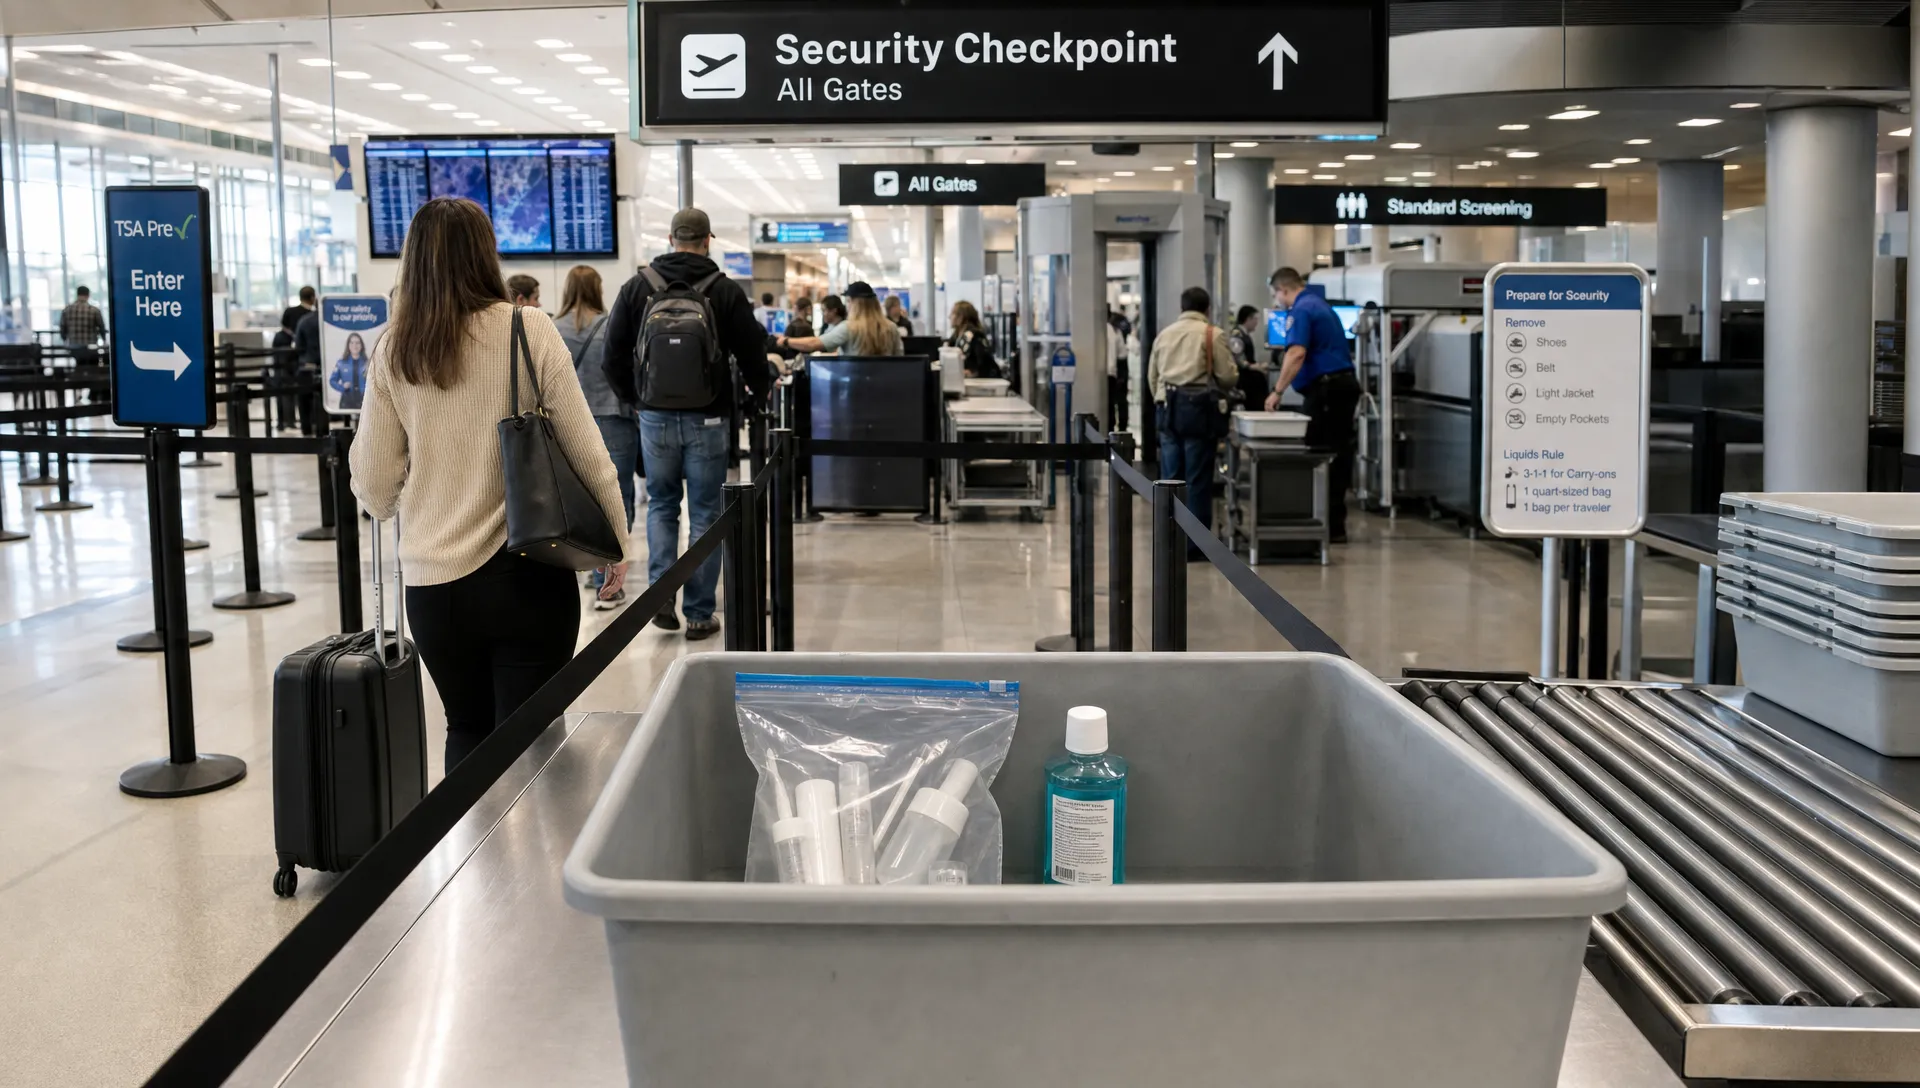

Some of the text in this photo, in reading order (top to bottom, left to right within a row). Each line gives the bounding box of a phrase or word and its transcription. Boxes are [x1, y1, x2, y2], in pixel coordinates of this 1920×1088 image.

[775, 29, 1178, 72] Security Checkpoint
[777, 77, 903, 102] All Gates
[907, 175, 978, 193] All Gates
[1387, 198, 1533, 221] Standard Screening
[114, 220, 145, 237] TSA
[131, 269, 185, 291] Enter
[1506, 289, 1610, 303] Prepare for Sceurity
[135, 295, 182, 317] Here
[1505, 317, 1546, 328] Remove
[1536, 337, 1567, 348] Shoes
[1536, 362, 1556, 373] Belt
[1536, 388, 1594, 400] Light Jacket
[1536, 413, 1610, 426] Empty Pockets
[1503, 449, 1565, 461] Liquids Rule
[1523, 468, 1617, 481] 3-1-1 for Carry-ons
[1524, 486, 1612, 499] 1 quart-sized bag
[1524, 502, 1611, 515] 1 bag per traveler
